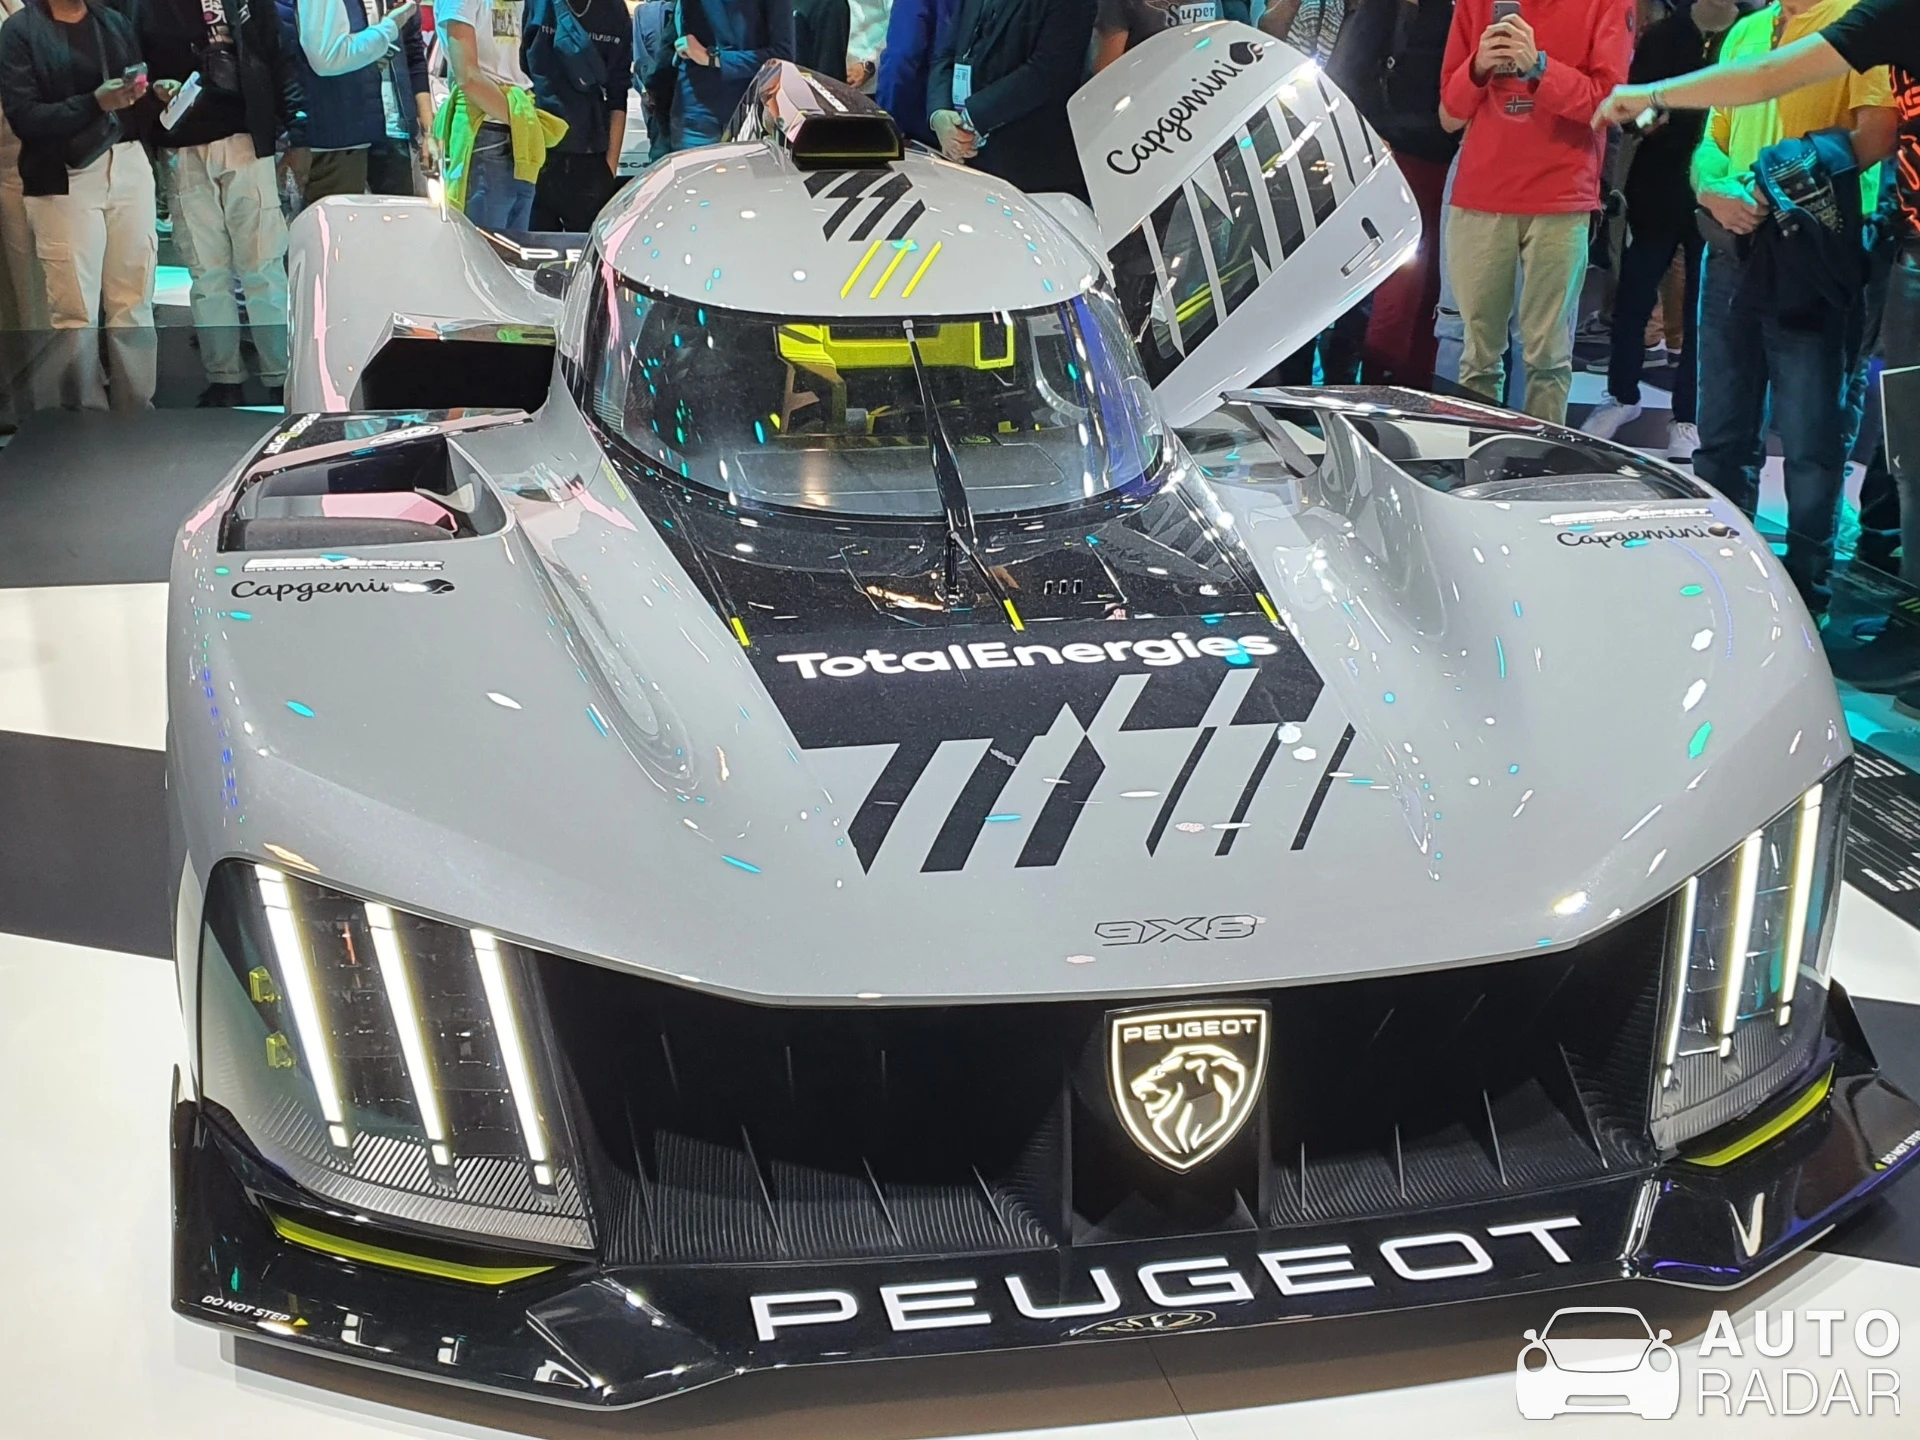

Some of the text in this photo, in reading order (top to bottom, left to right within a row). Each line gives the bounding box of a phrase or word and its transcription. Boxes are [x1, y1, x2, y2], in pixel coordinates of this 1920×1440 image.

[1168, 4, 1215, 27] Super
[1106, 59, 1243, 175] Capgemini
[1556, 525, 1708, 549] Capgemini
[231, 578, 414, 602] Capgemi
[777, 632, 1278, 679] TotalEnergies
[1094, 915, 1258, 946] 9X8
[1122, 1019, 1257, 1043] PEUGEOT
[749, 1217, 1582, 1341] PEUGEOT
[201, 1295, 291, 1321] DO NOT STEP
